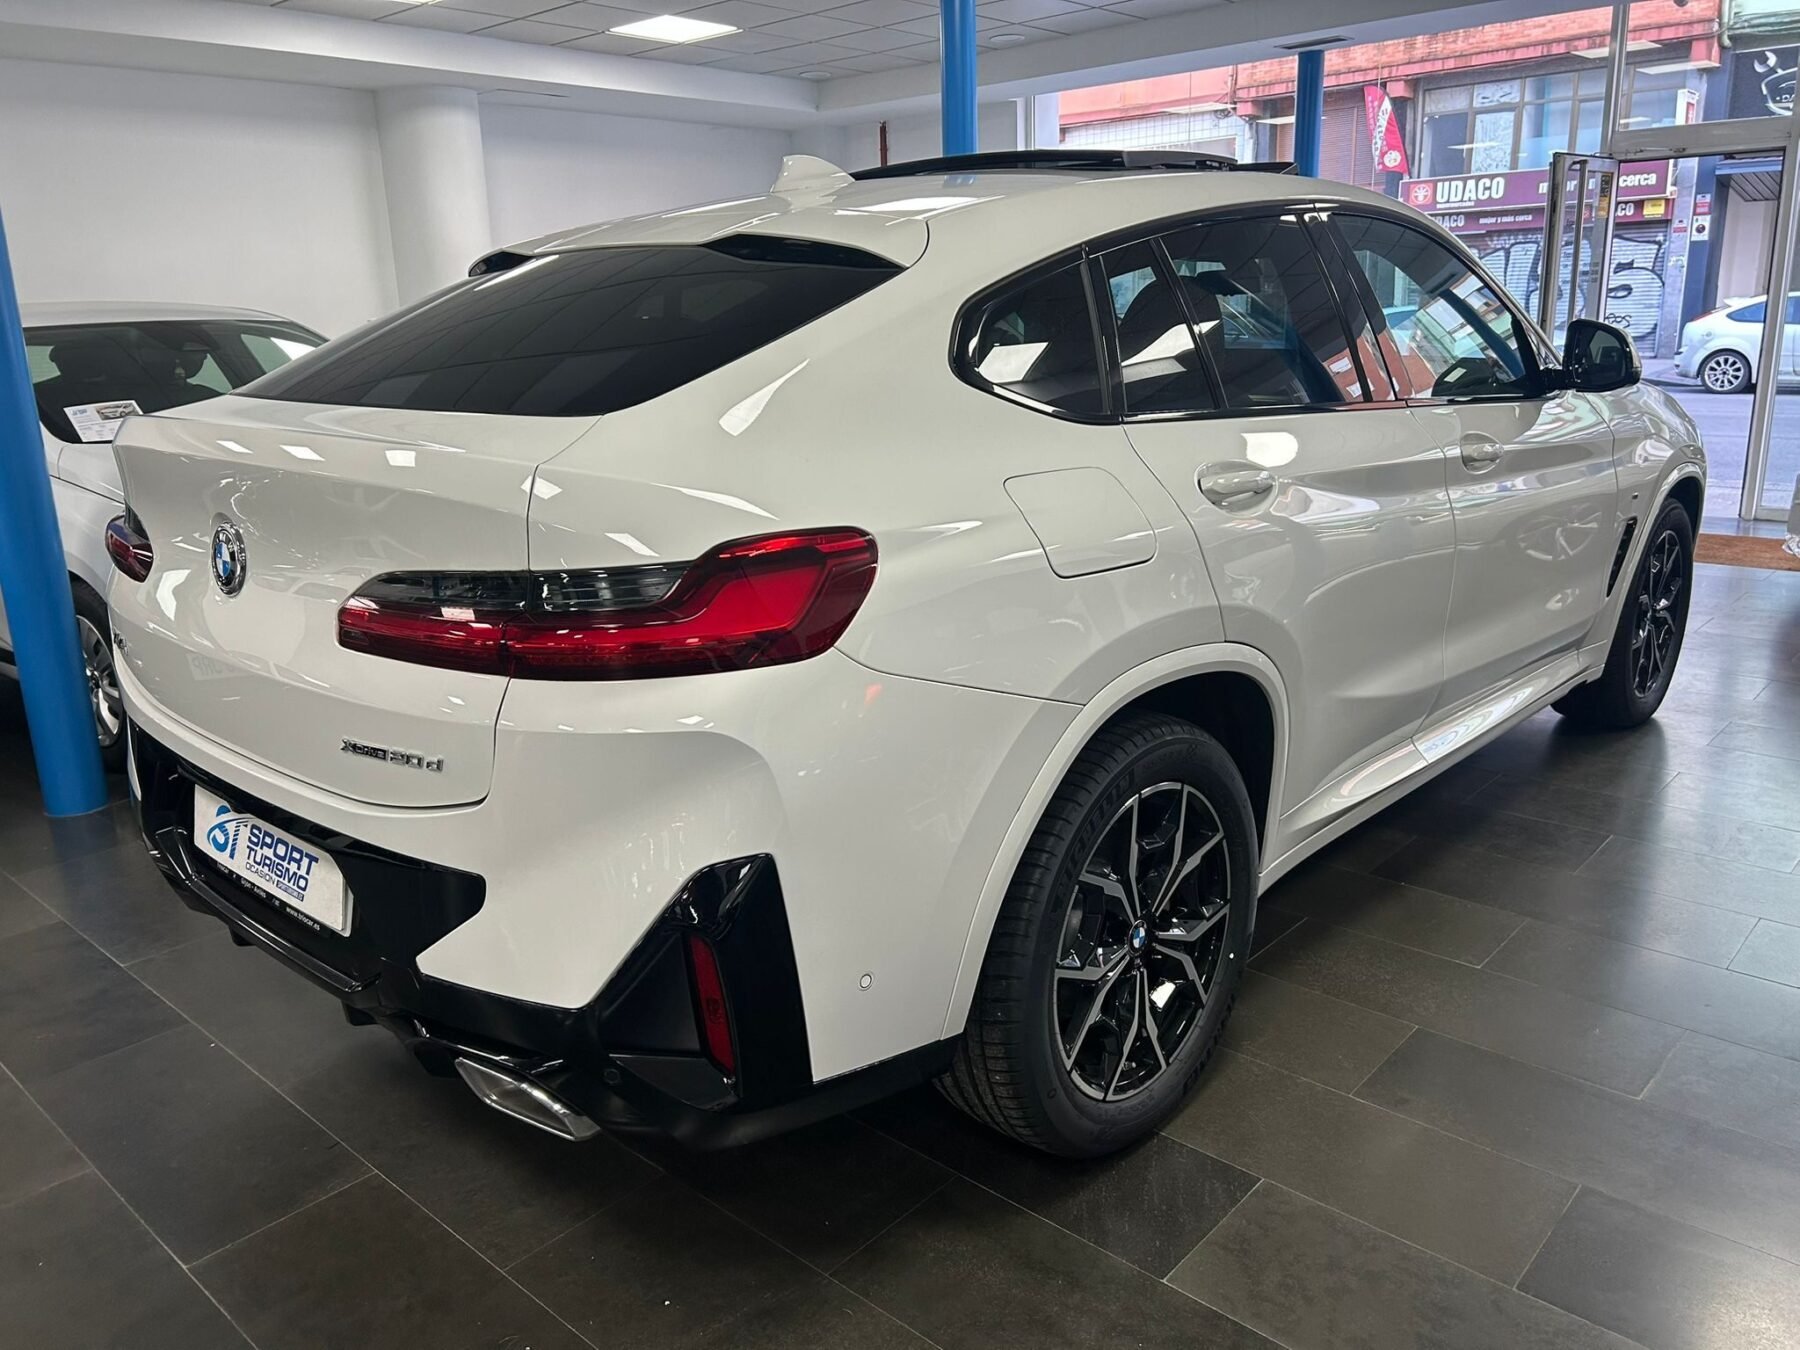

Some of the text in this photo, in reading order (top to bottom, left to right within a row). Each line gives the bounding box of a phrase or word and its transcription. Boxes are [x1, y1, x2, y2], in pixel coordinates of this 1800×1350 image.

[1436, 177, 1505, 203] UDACO
[1619, 172, 1657, 188] cerca
[1515, 213, 1533, 222] cerca
[248, 823, 319, 877] SPORT
[245, 861, 276, 886] OCASION
[246, 844, 309, 892] TURISMO
